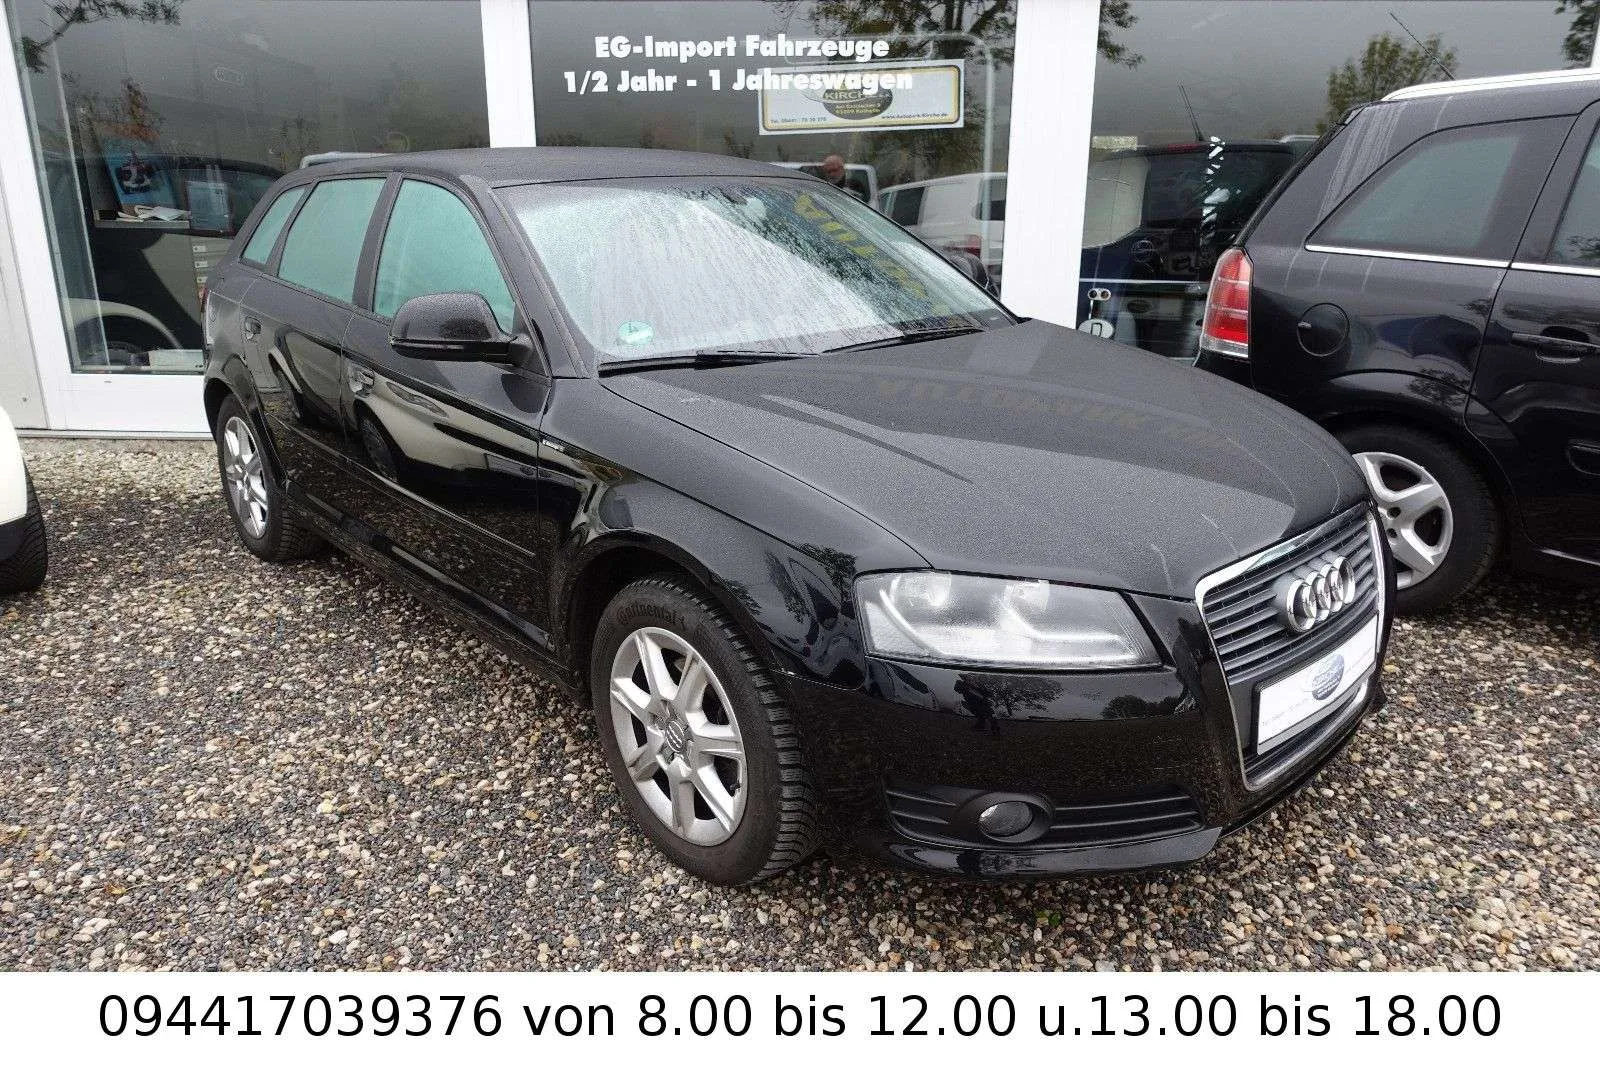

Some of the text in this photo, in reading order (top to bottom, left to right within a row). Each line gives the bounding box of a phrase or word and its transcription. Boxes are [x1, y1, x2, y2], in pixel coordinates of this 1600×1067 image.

[594, 33, 890, 63] EG-Import Fahrzeuge
[563, 70, 609, 95] 1/2
[616, 68, 678, 93] Jahr
[709, 69, 721, 91] 1
[732, 68, 913, 95] Jahreswagen
